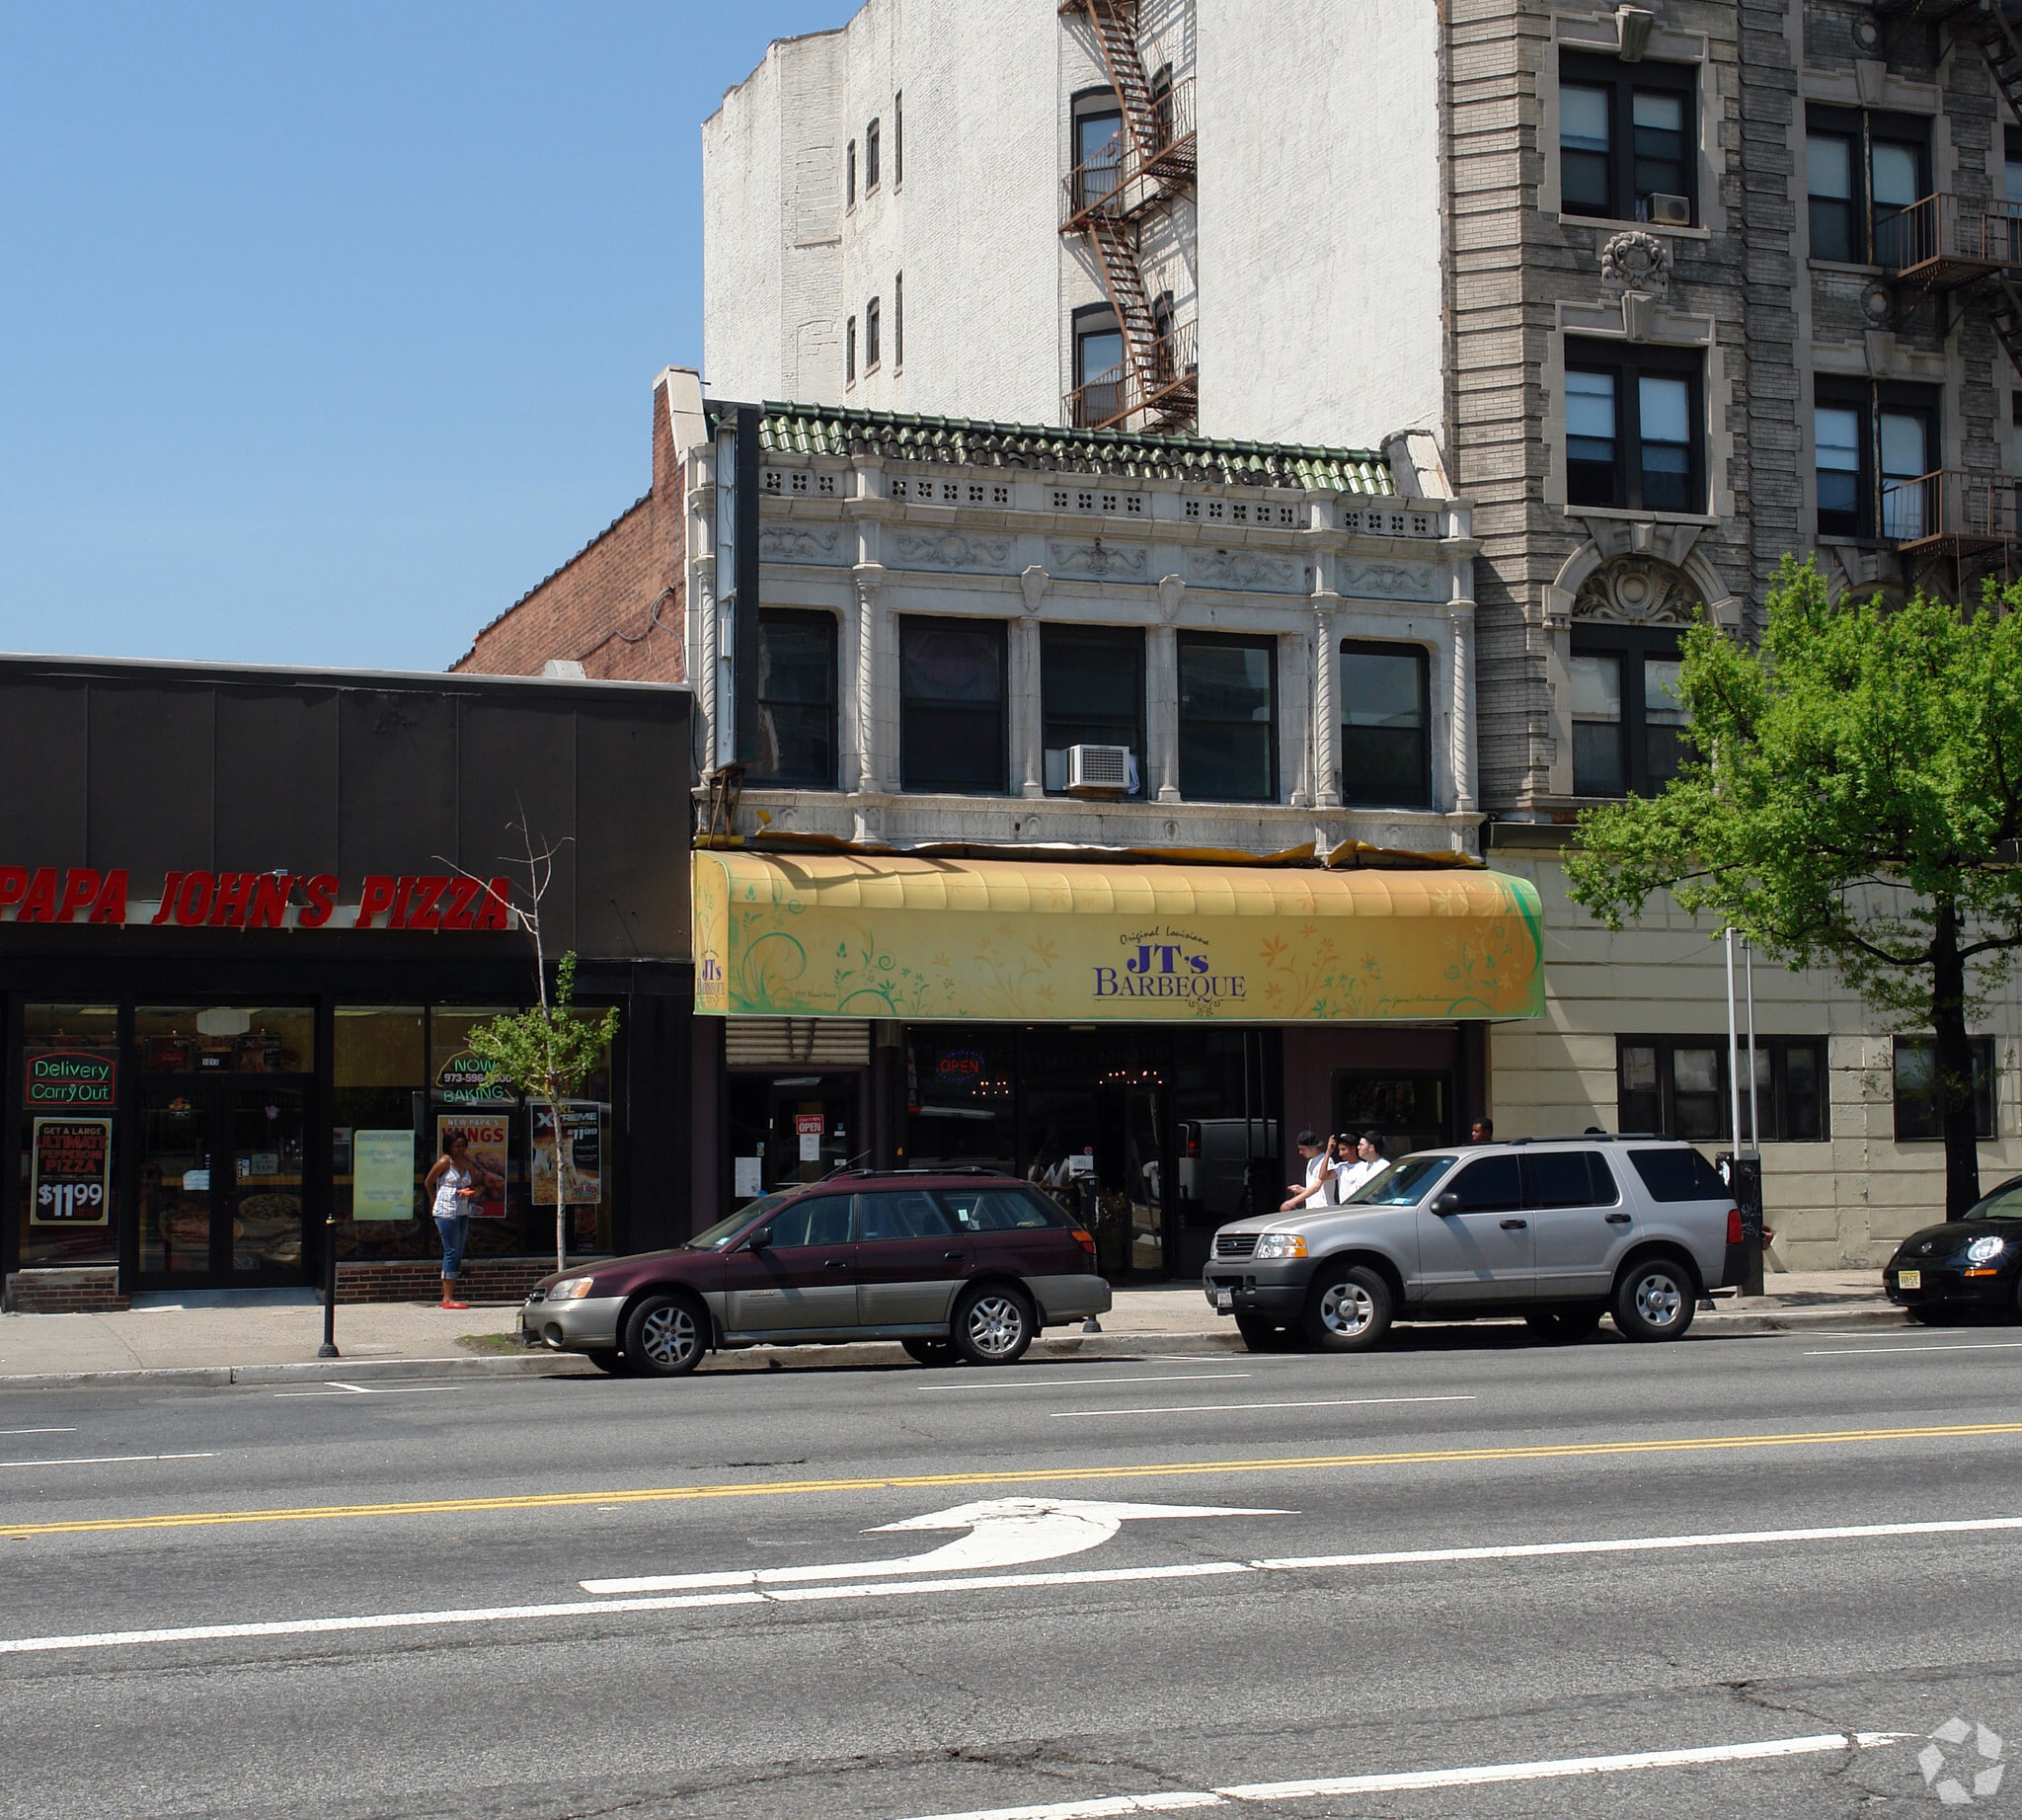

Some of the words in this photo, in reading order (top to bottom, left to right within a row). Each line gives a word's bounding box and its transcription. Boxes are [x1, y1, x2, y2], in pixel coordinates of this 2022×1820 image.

[0, 864, 128, 923] PAPA
[152, 869, 340, 928] JOHN'S
[353, 875, 509, 930] PIZZA
[1120, 926, 1160, 945] Original
[1166, 926, 1209, 945] Louisiana
[1127, 943, 1209, 974] JT's
[1091, 967, 1247, 1002] BARBEQUE
[35, 1060, 109, 1080] Delivery
[454, 1059, 497, 1072] NOW
[940, 1058, 979, 1073] OPEN
[443, 1085, 505, 1103] BAKING
[71, 1127, 102, 1136] LARGE
[799, 1122, 821, 1133] OPEN
[37, 1135, 109, 1149] ULTIMATE
[39, 1148, 104, 1159] PEPPERONI
[44, 1159, 97, 1173] PIZZA
